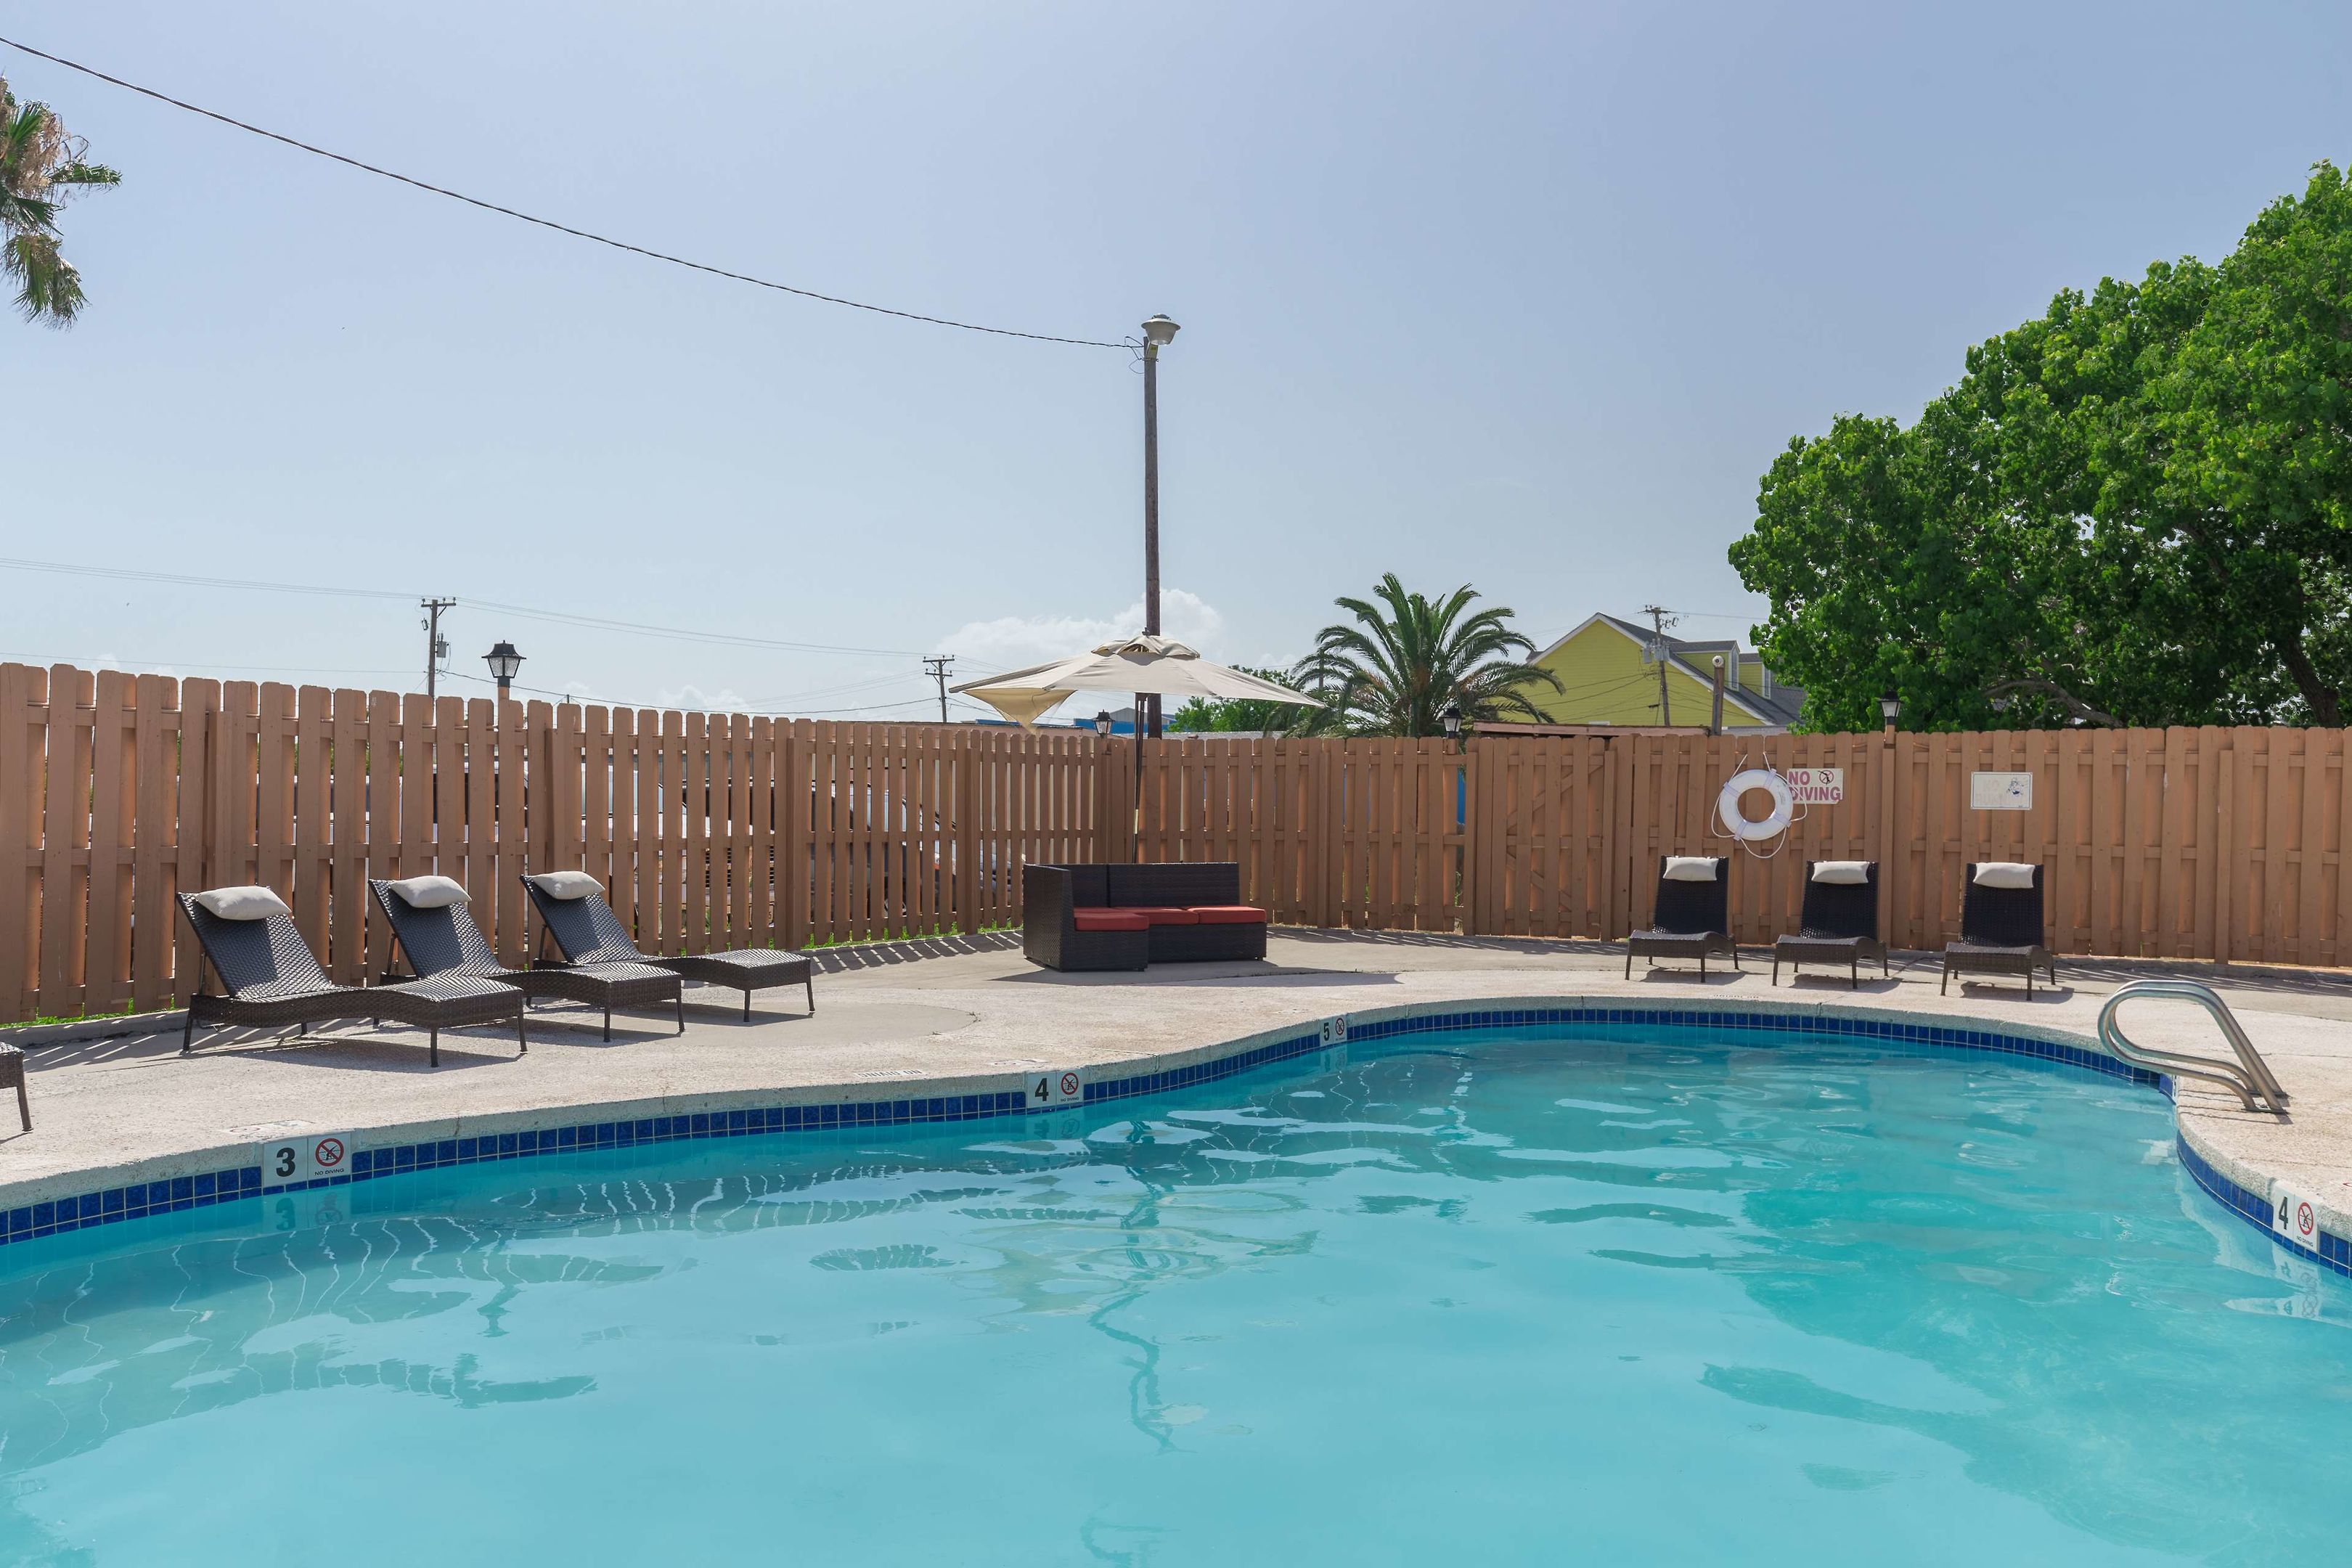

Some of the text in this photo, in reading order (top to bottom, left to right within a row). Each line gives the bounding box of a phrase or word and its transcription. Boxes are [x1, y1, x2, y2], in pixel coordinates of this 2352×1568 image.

[1789, 771, 1810, 785] NO
[1789, 786, 1841, 801] DIVING
[1323, 1022, 1330, 1041] 5
[1034, 1077, 1049, 1102] 4
[276, 1147, 296, 1177] 3
[2278, 1196, 2289, 1230] 4
